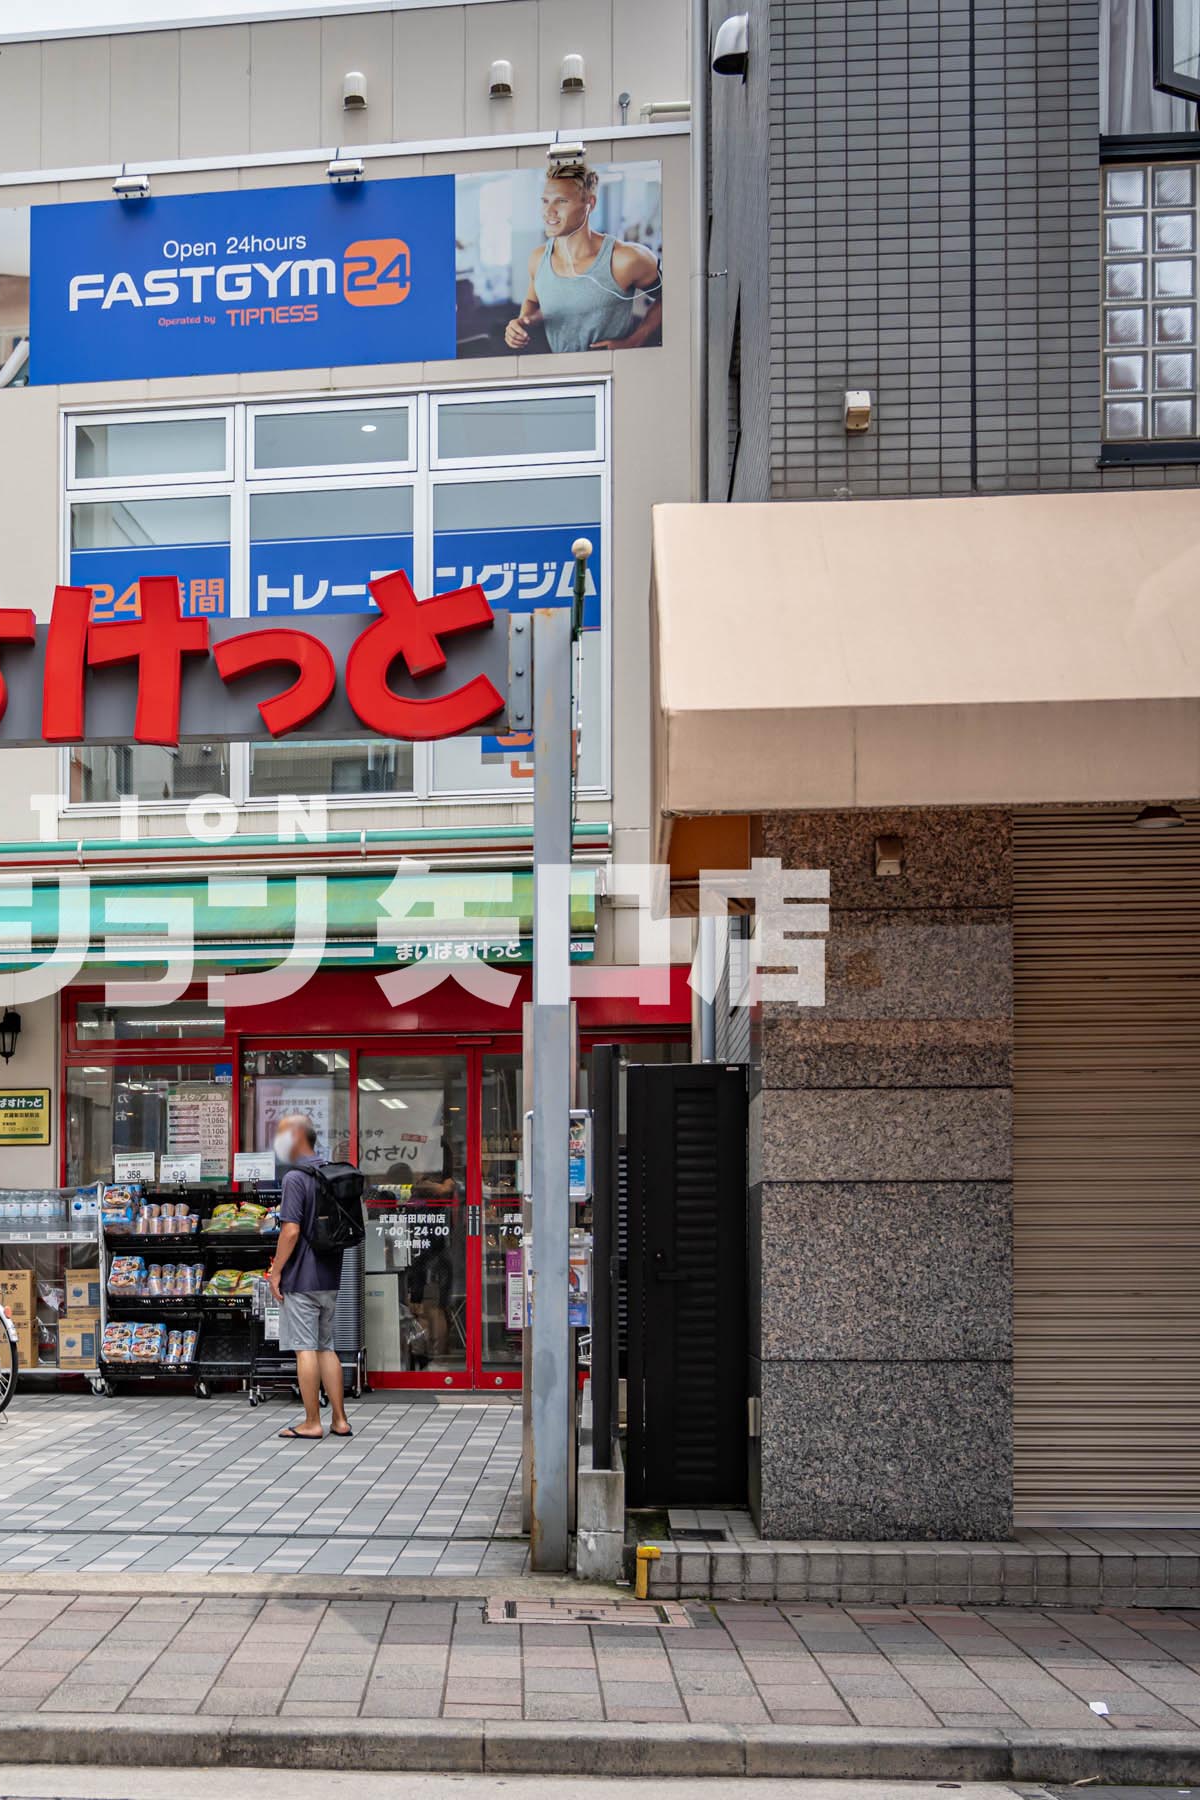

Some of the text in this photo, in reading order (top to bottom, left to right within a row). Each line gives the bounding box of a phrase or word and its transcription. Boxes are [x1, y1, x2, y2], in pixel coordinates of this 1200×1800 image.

[163, 235, 306, 261] Open 24hours
[69, 252, 412, 312] FASTGYM 24
[158, 304, 318, 327] Operated by TIPNESS
[395, 941, 522, 961] まいばすけっと
[127, 1170, 141, 1179] 358
[172, 1171, 187, 1180] 99
[246, 1169, 261, 1177] 78
